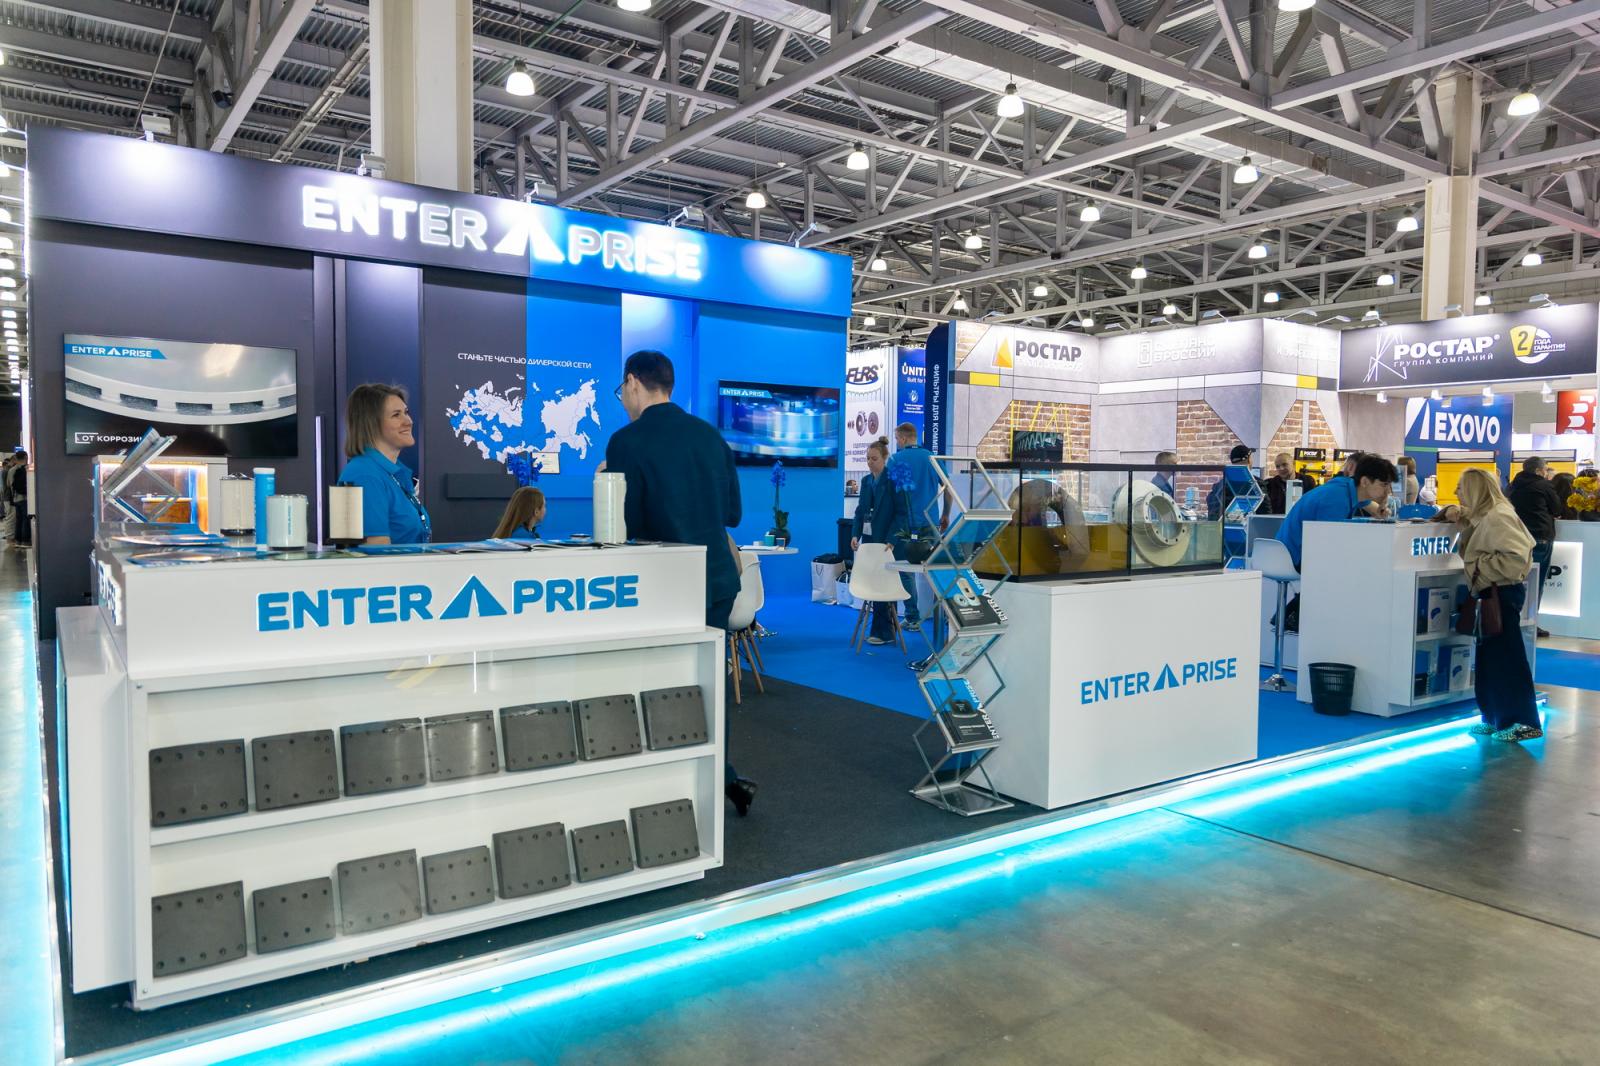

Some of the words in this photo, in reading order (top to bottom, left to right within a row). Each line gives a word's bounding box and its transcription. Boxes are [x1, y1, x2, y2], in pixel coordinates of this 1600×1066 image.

[302, 184, 488, 251] ENTER
[568, 225, 702, 281] PRISE
[71, 345, 106, 356] ENTER
[121, 350, 152, 358] PRISE
[1015, 340, 1082, 362] РОСТАР
[1393, 335, 1494, 361] РОСТАР
[1517, 330, 1529, 351] 2
[457, 352, 494, 362] СТАНЬТЕ
[494, 355, 527, 365] ЧАСТЬЮ
[527, 358, 573, 368] ДИЛЕРСКОЙ
[573, 361, 592, 369] СЕТИ
[1393, 358, 1432, 368] ГРУППА
[1435, 352, 1495, 365] КОМПАНИЙ
[932, 363, 940, 404] ФИЛЬТРЫ
[82, 434, 95, 443] ОТ
[1434, 412, 1501, 445] EXOVO
[1411, 535, 1450, 557] ENTER
[256, 585, 434, 632] ENTER
[511, 575, 639, 615] PRISE
[1080, 671, 1150, 705] ENTER
[1182, 657, 1237, 686] PRISE
